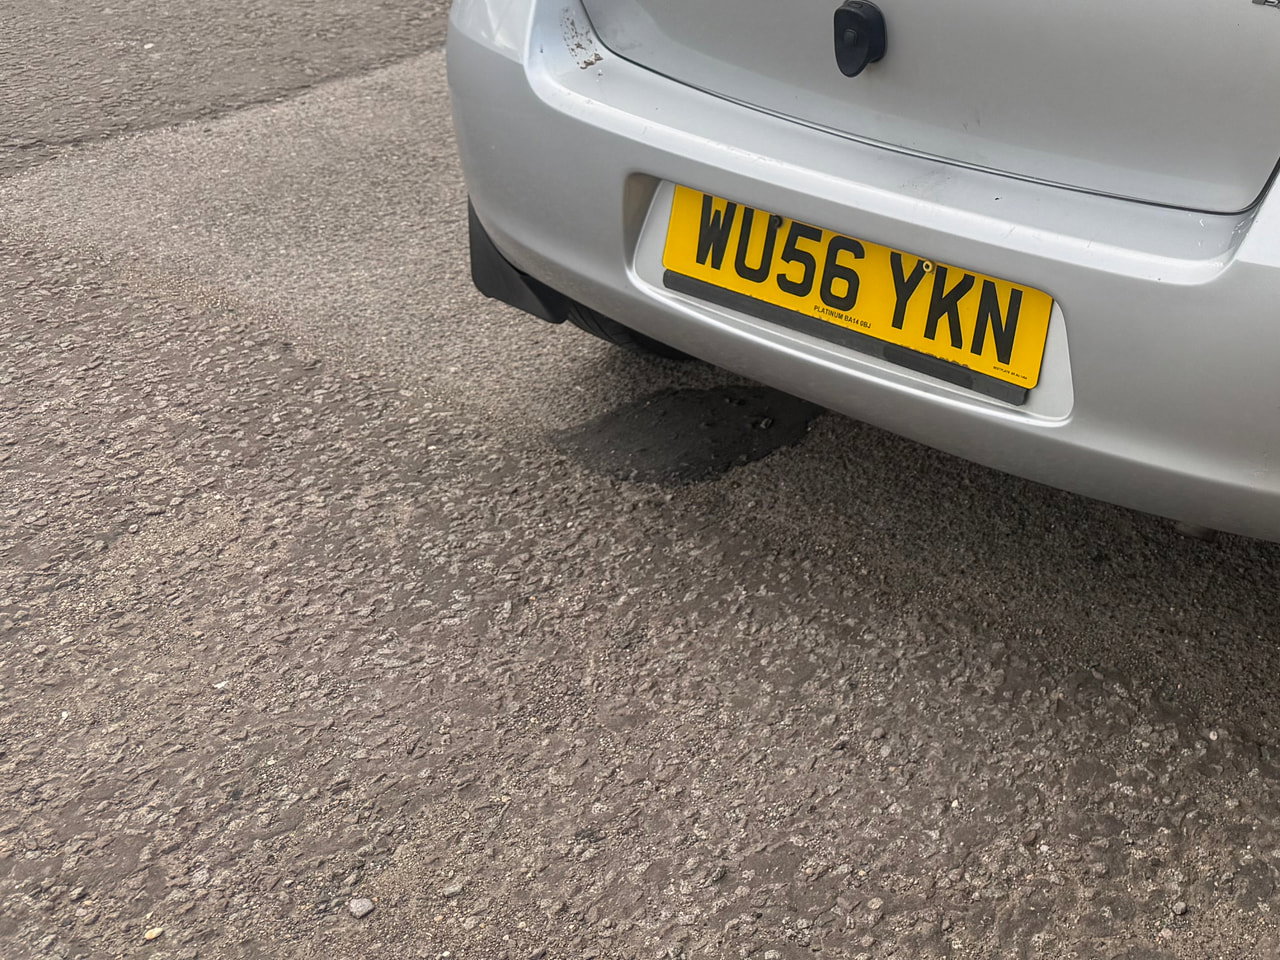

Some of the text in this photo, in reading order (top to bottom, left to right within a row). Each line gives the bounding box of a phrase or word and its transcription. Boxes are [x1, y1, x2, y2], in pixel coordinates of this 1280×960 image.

[696, 194, 1023, 365] WU56 YKN
[813, 304, 843, 320] PLATINUM
